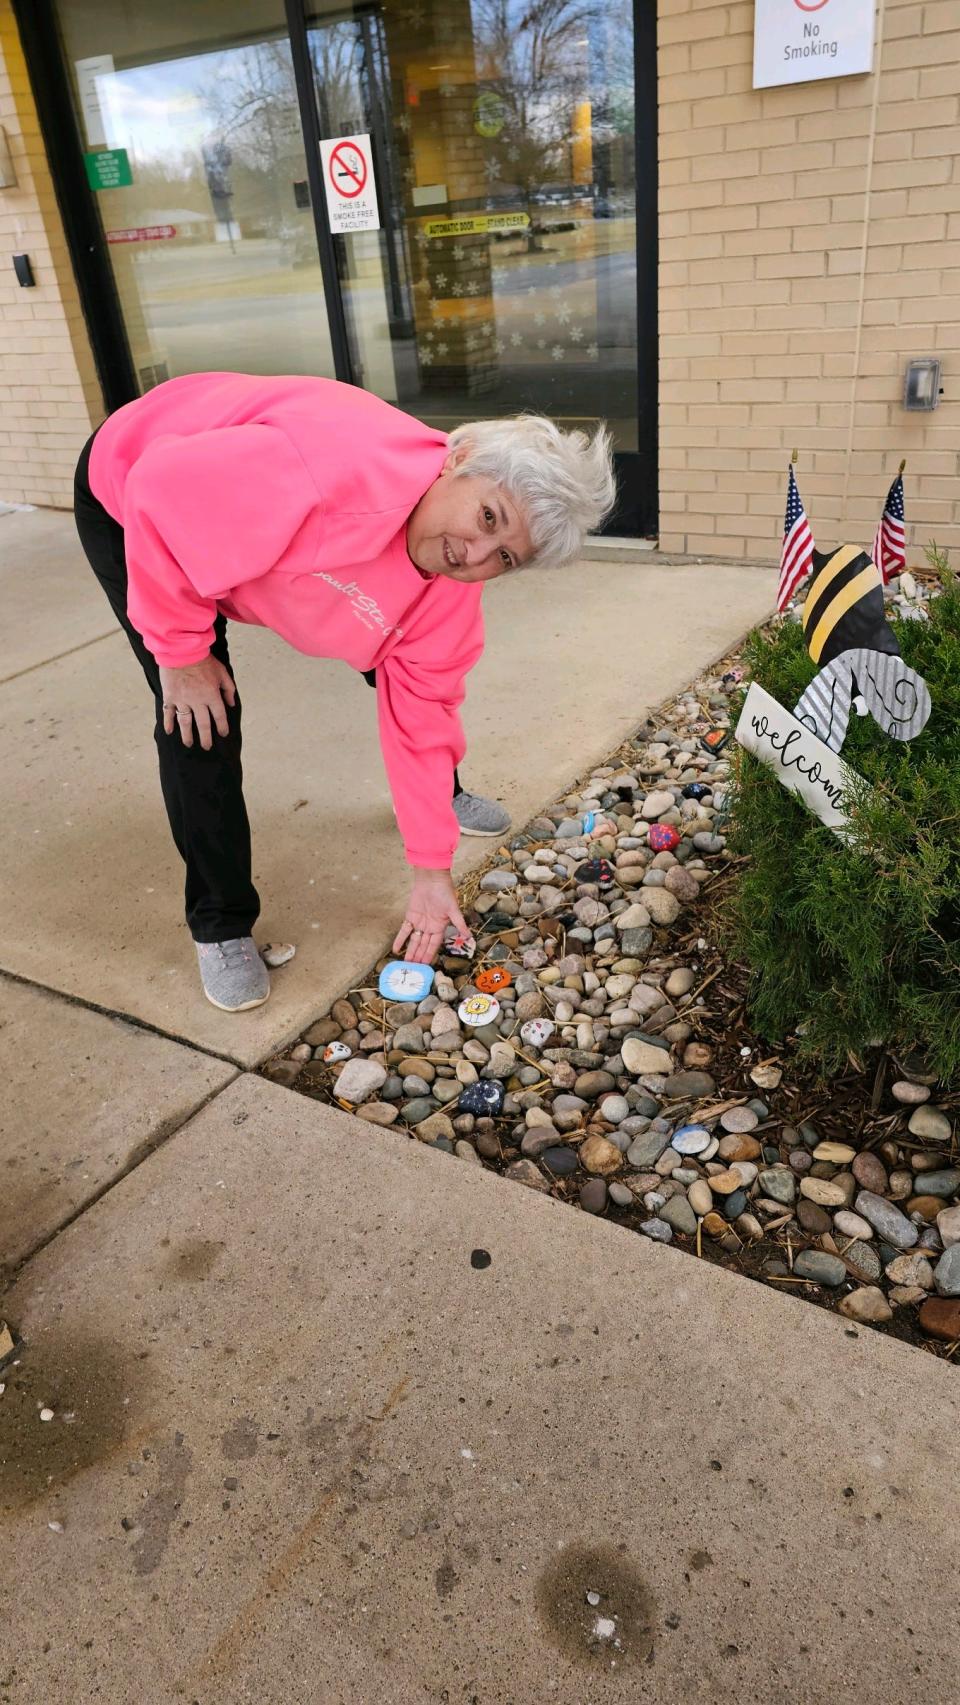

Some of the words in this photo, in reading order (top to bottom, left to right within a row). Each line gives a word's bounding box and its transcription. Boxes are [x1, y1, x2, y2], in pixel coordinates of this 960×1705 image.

[803, 22, 820, 38] No
[783, 40, 838, 61] Smoking
[338, 202, 353, 210] THIS
[354, 201, 360, 209] IS
[333, 211, 356, 221] SMOKE
[357, 209, 374, 219] FREE
[340, 220, 369, 230] FACILITY
[429, 222, 459, 235] AUTOMATIC
[459, 220, 474, 231] DOOR
[487, 217, 505, 229] STAND
[506, 215, 524, 227] CLEAR
[751, 715, 844, 809] welcom
